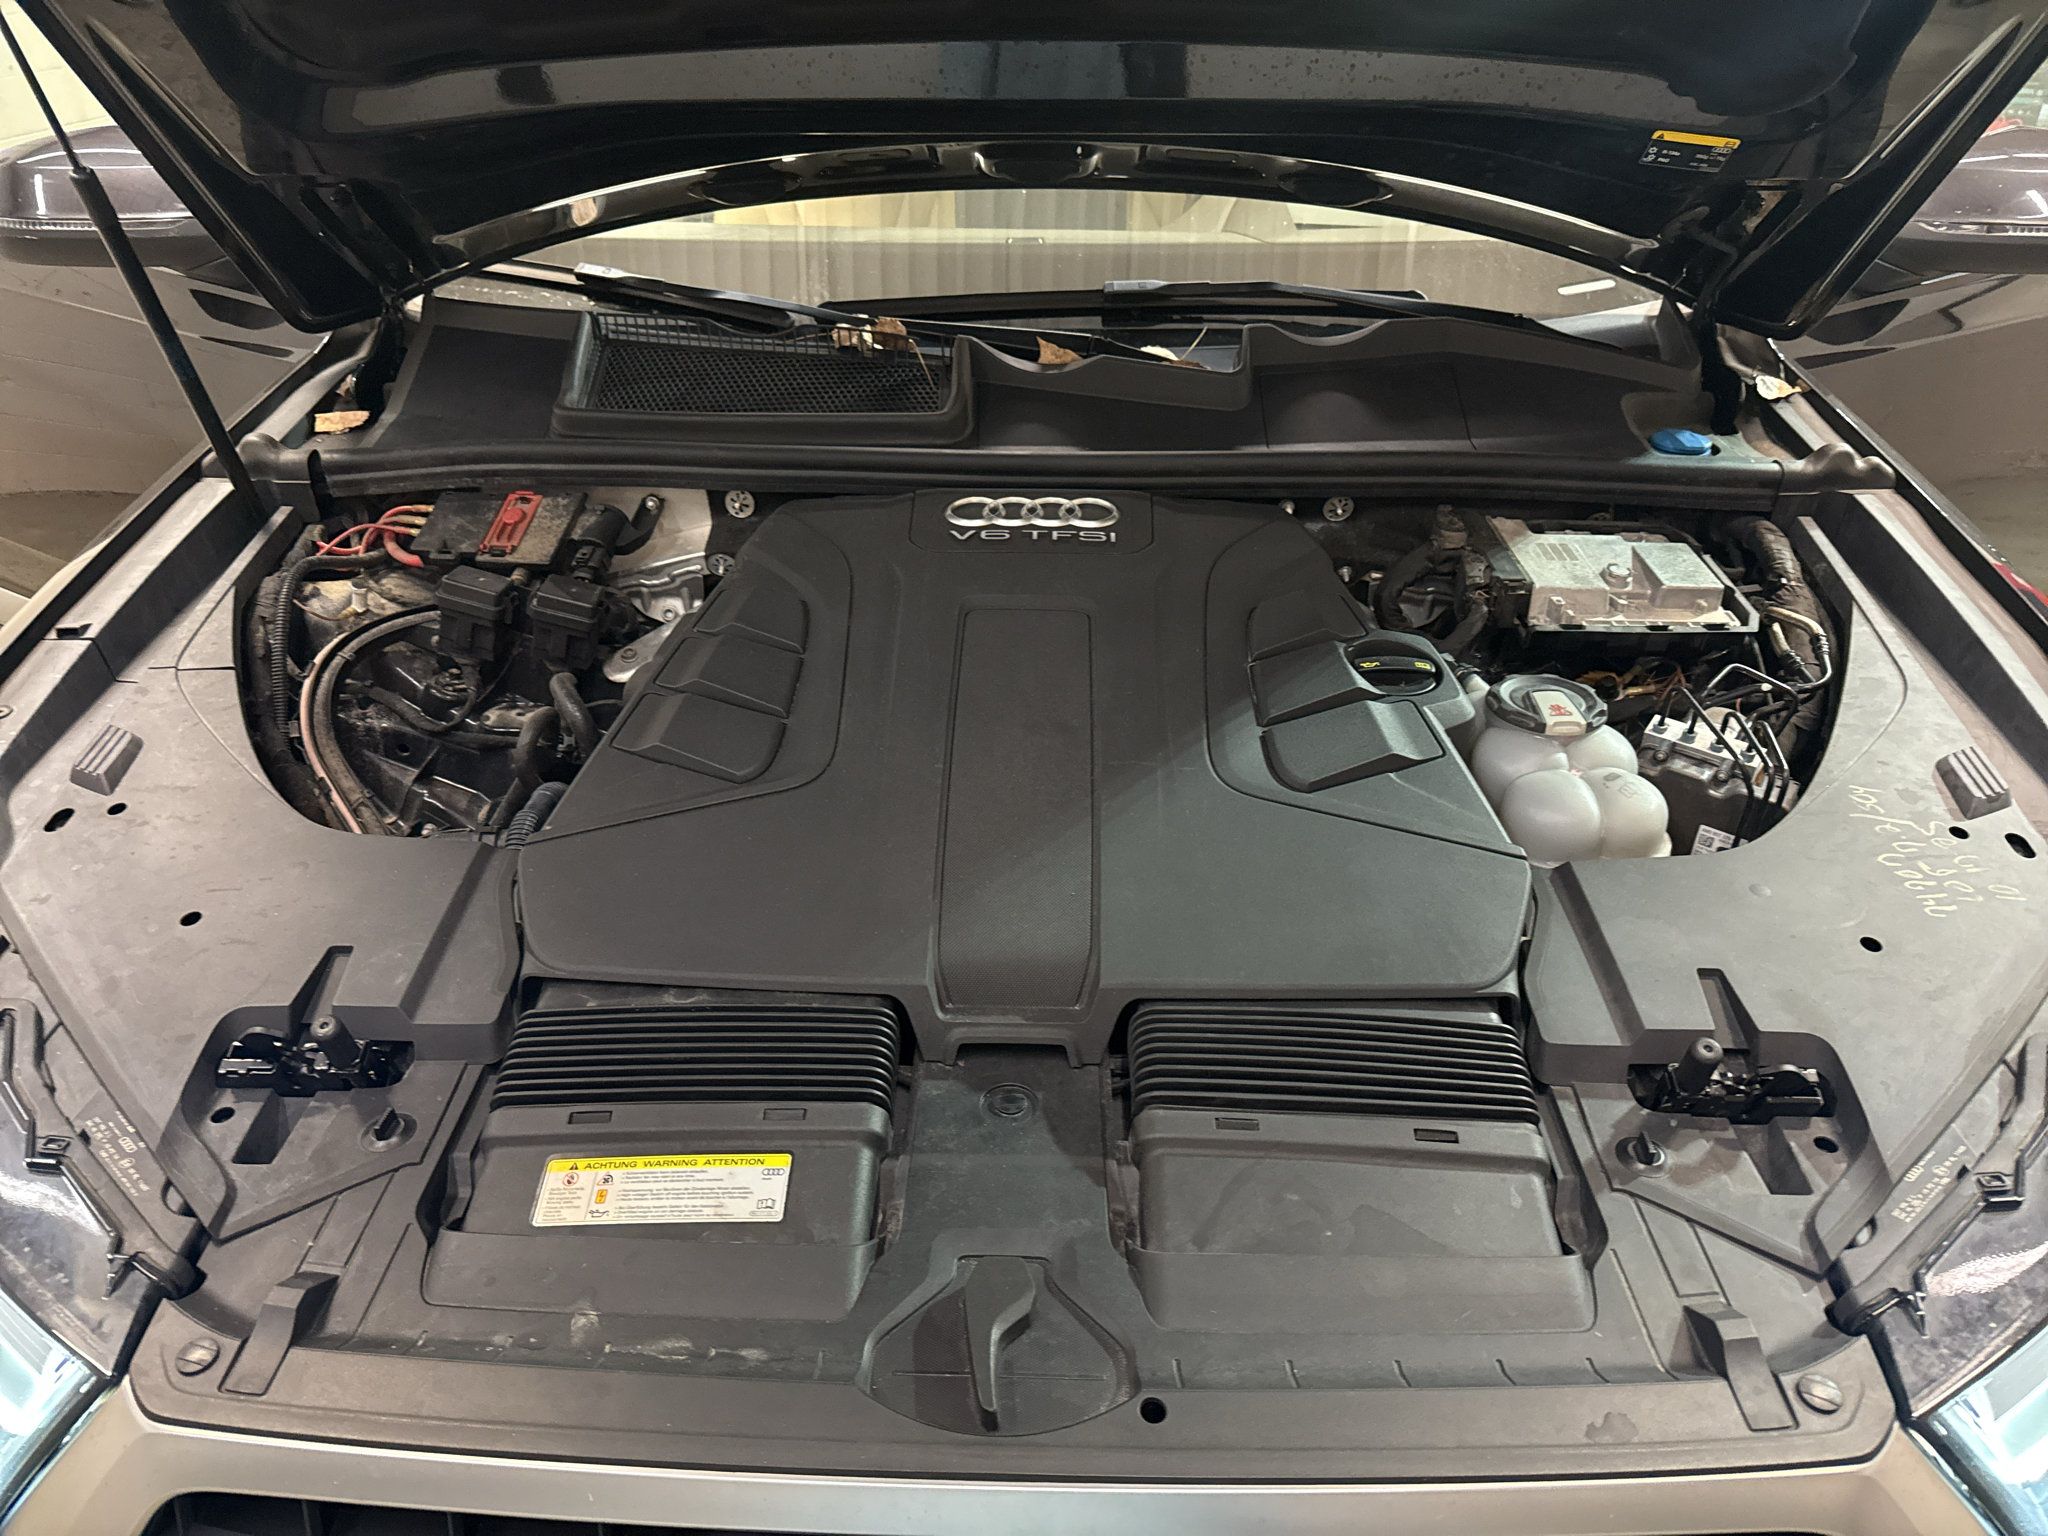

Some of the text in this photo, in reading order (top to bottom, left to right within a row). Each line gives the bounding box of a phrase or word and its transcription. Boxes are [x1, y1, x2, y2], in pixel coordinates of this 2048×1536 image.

[950, 529, 1117, 543] V6 TFSI
[584, 1158, 765, 1170] ACHTUNG WARNING ATTENTION
